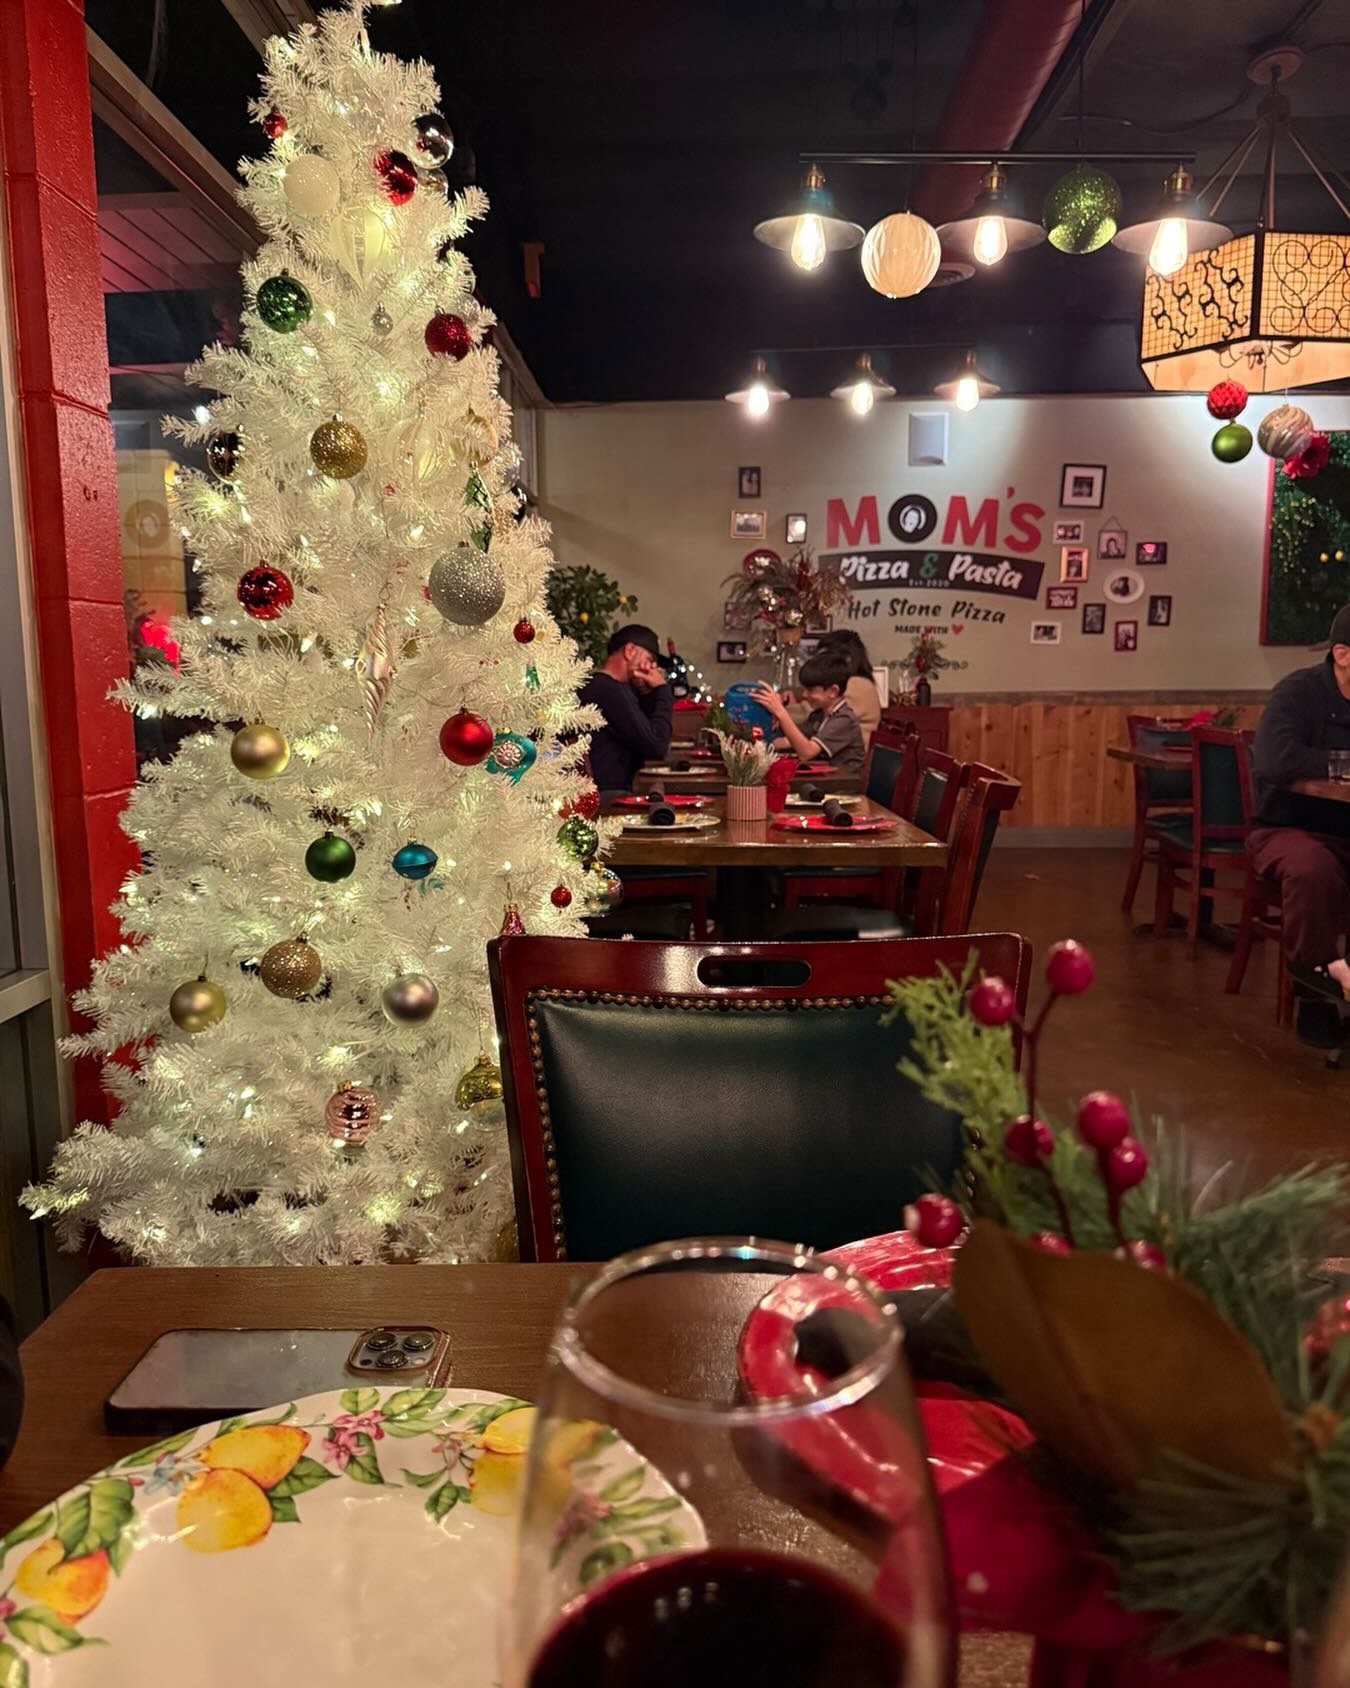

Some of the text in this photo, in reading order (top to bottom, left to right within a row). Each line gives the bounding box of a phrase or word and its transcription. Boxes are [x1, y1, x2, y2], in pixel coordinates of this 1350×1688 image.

[826, 486, 1046, 554] MOM'S
[839, 552, 1023, 590] Pizza & Pasta
[847, 598, 1006, 624] Hot Stone Pizza
[894, 624, 921, 634] MADE
